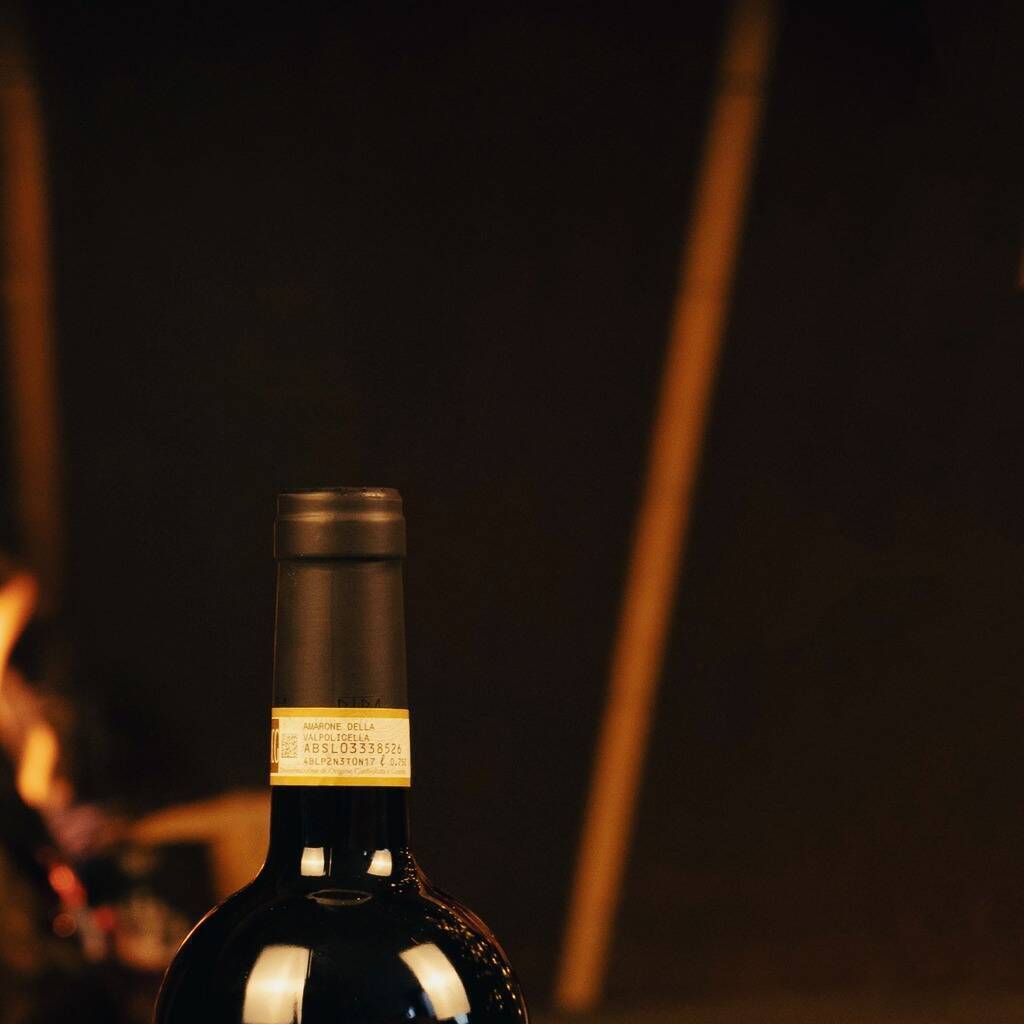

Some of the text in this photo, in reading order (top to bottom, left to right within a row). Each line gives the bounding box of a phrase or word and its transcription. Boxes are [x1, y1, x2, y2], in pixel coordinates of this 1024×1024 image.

[303, 723, 375, 731] AMARONE DELLA
[303, 733, 370, 742] VALPOLICELLA
